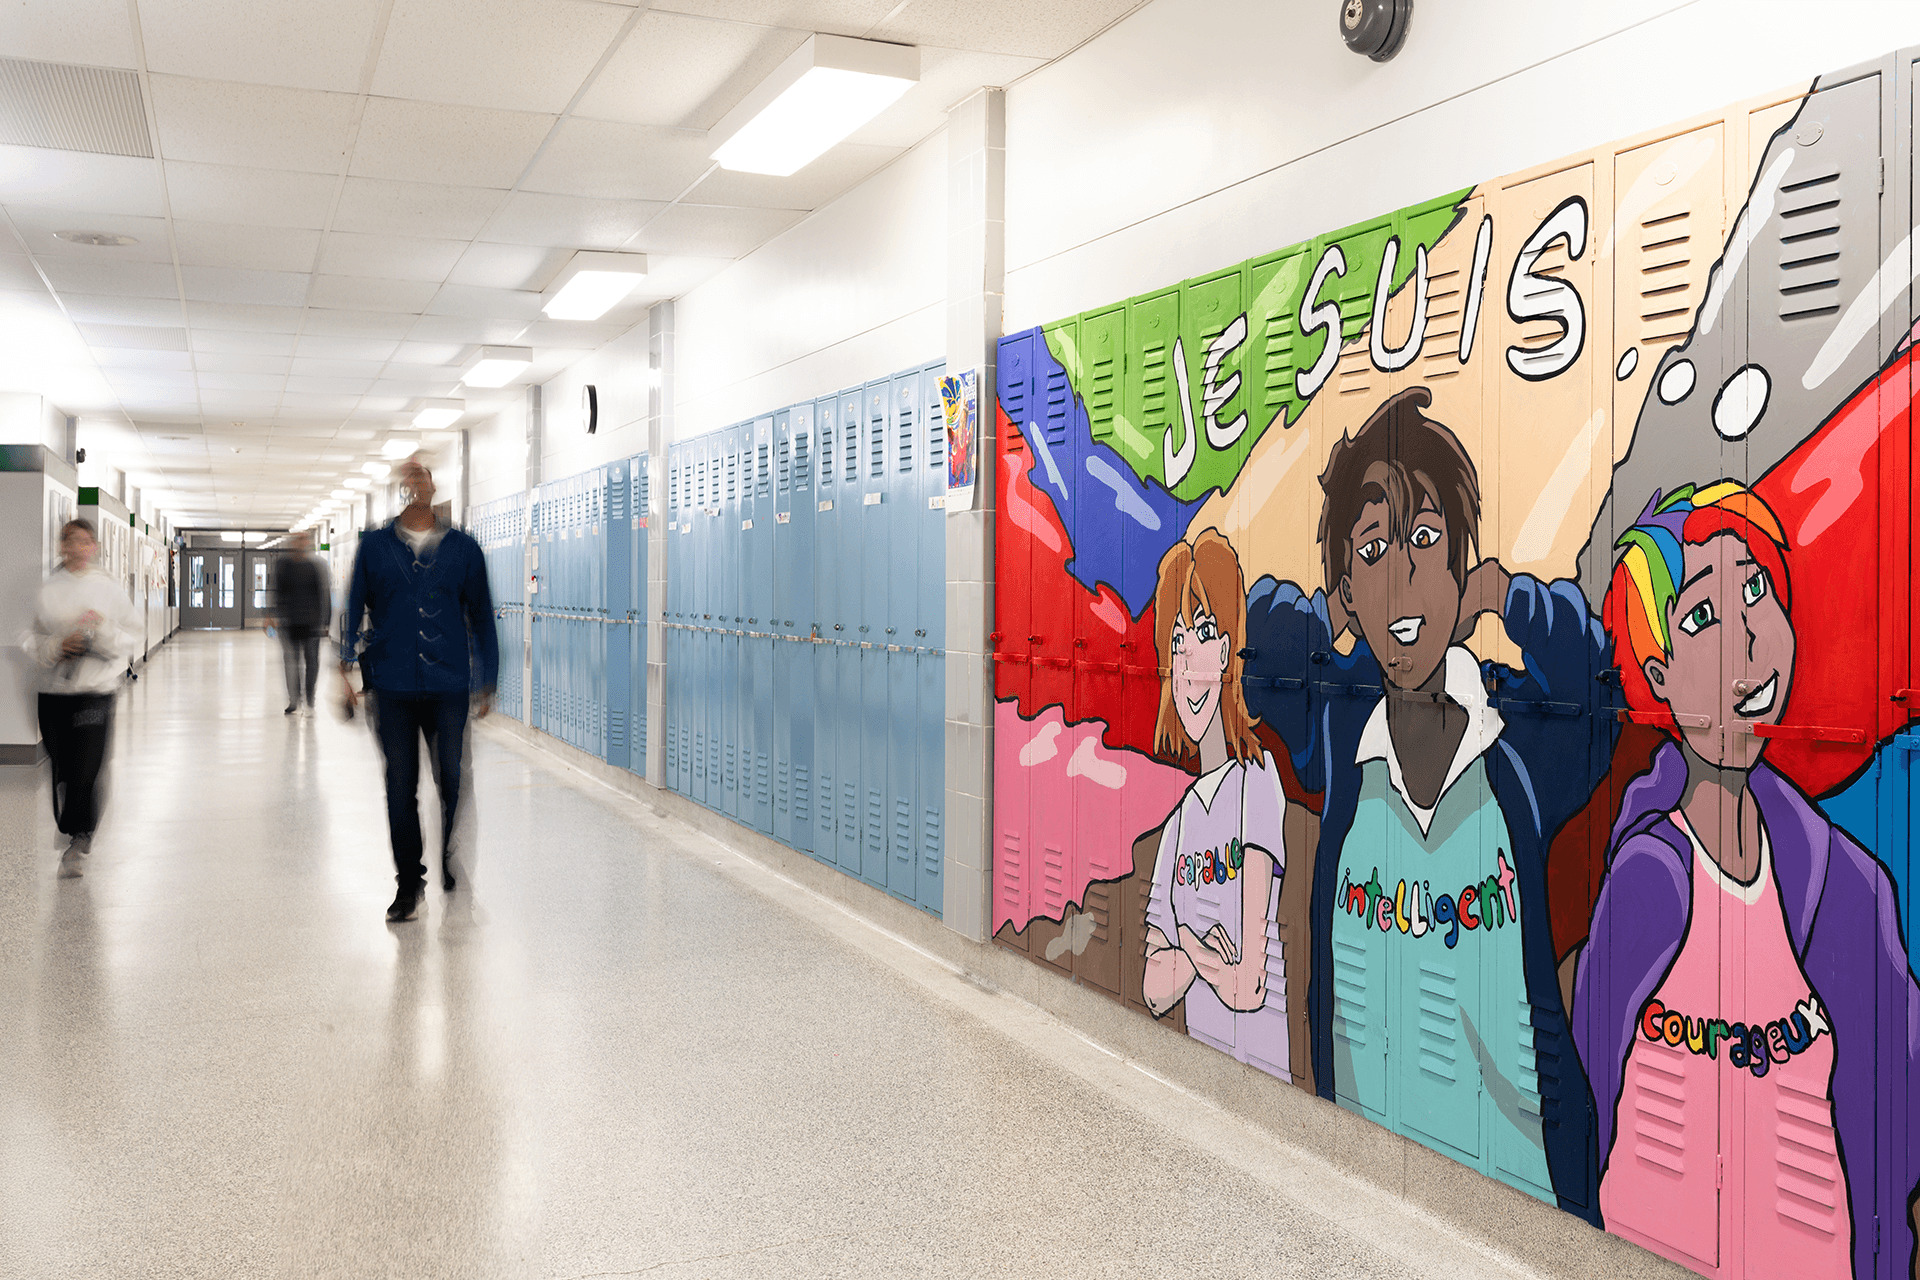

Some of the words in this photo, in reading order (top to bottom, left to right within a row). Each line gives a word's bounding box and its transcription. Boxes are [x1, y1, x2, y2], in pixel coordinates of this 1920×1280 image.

[1163, 311, 1248, 489] JE
[1176, 836, 1243, 892] capable
[1338, 846, 1517, 950] intelligent
[1641, 991, 1831, 1078] courageux
